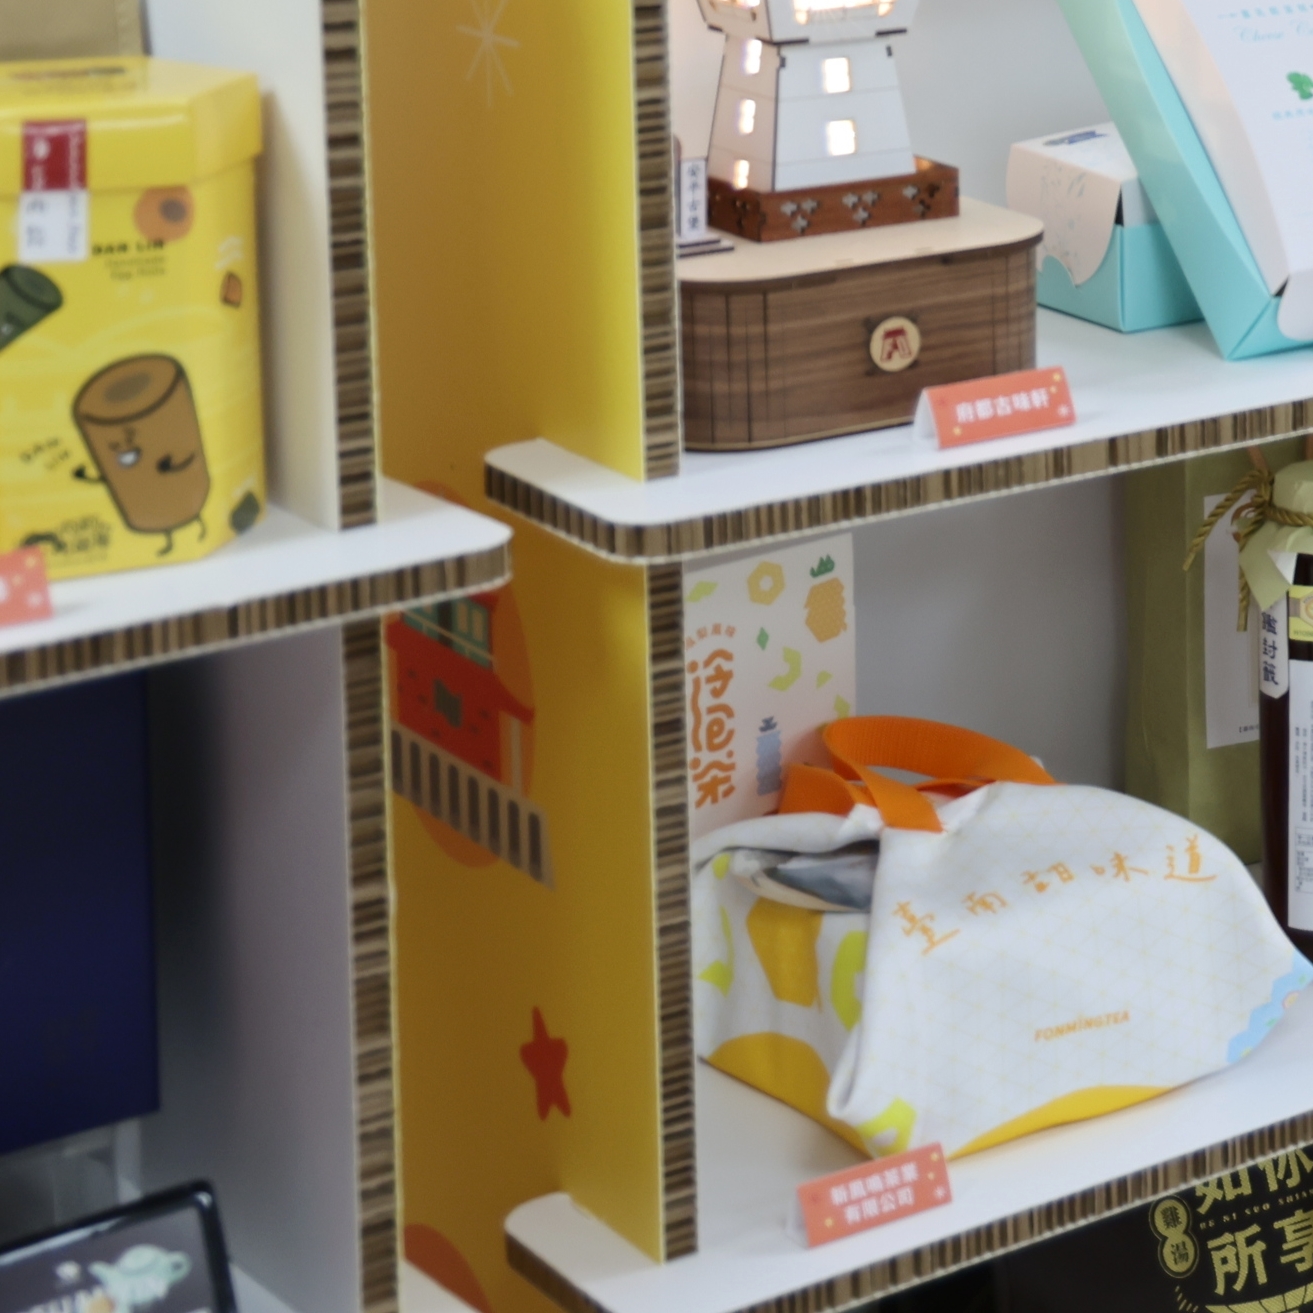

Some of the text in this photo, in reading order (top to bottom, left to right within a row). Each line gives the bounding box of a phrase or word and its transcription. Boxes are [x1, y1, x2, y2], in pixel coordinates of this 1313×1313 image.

[844, 1186, 915, 1225] 有限公司
[1160, 1205, 1189, 1267] 雞湯
